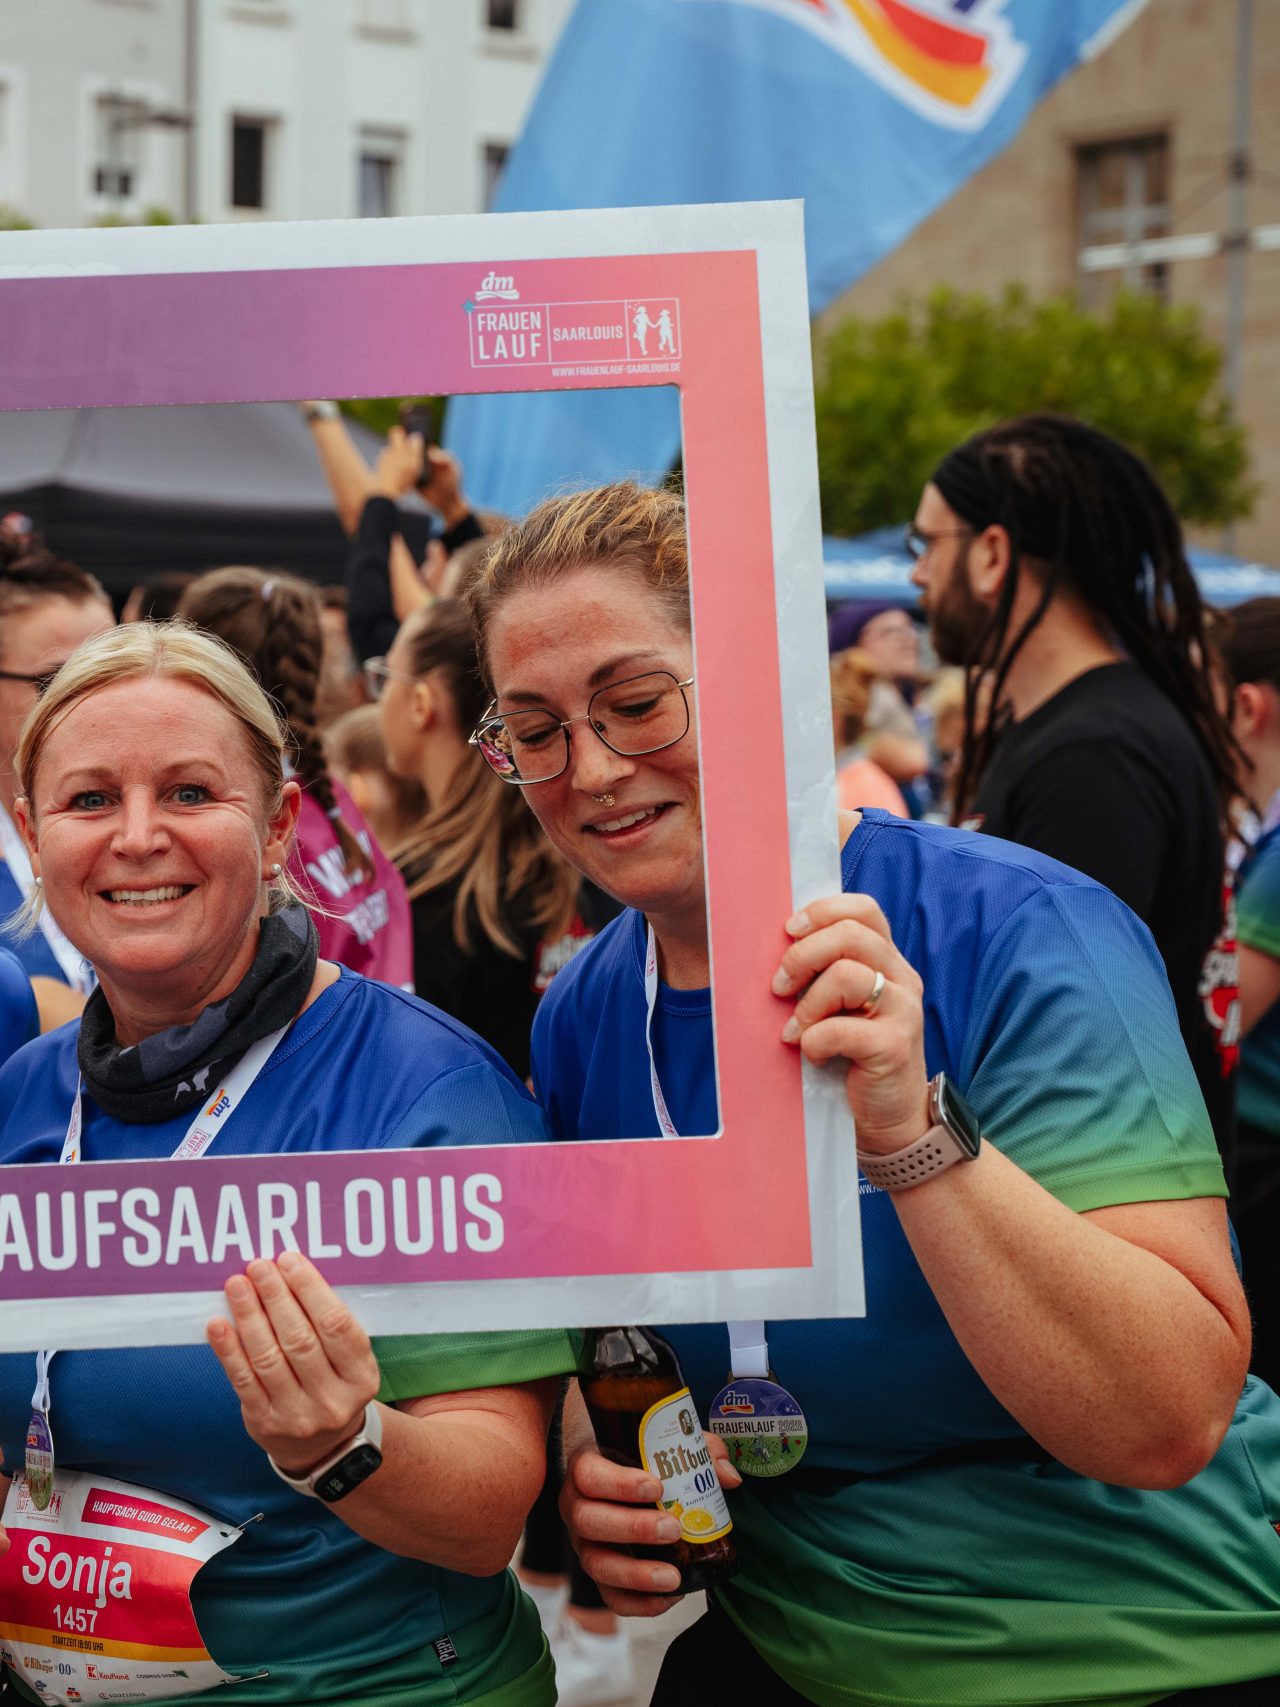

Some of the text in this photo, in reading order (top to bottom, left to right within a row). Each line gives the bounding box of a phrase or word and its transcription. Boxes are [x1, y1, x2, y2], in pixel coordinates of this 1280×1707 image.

[481, 271, 514, 291] dm
[477, 311, 542, 332] FRAUEN
[553, 324, 624, 342] SAARLOUIS
[479, 332, 542, 360] LAUF
[551, 362, 680, 377] WWW.FRAUENLAUF-SAARLOUIS.DE
[212, 1095, 231, 1118] dm
[187, 1130, 203, 1151] LAUF
[724, 1391, 749, 1406] dm
[712, 1421, 776, 1434] FRAUENLAUF
[741, 1460, 787, 1475] SAARLOUIS
[694, 1468, 715, 1493] 0.0
[93, 1501, 197, 1534] HAUPTSACH GUDD GELAAF
[22, 1535, 132, 1609] Sonja
[53, 1604, 98, 1633] 1457
[52, 1635, 104, 1651] STARTZEIT 18:00 UHR
[98, 1672, 129, 1681] Kaufland
